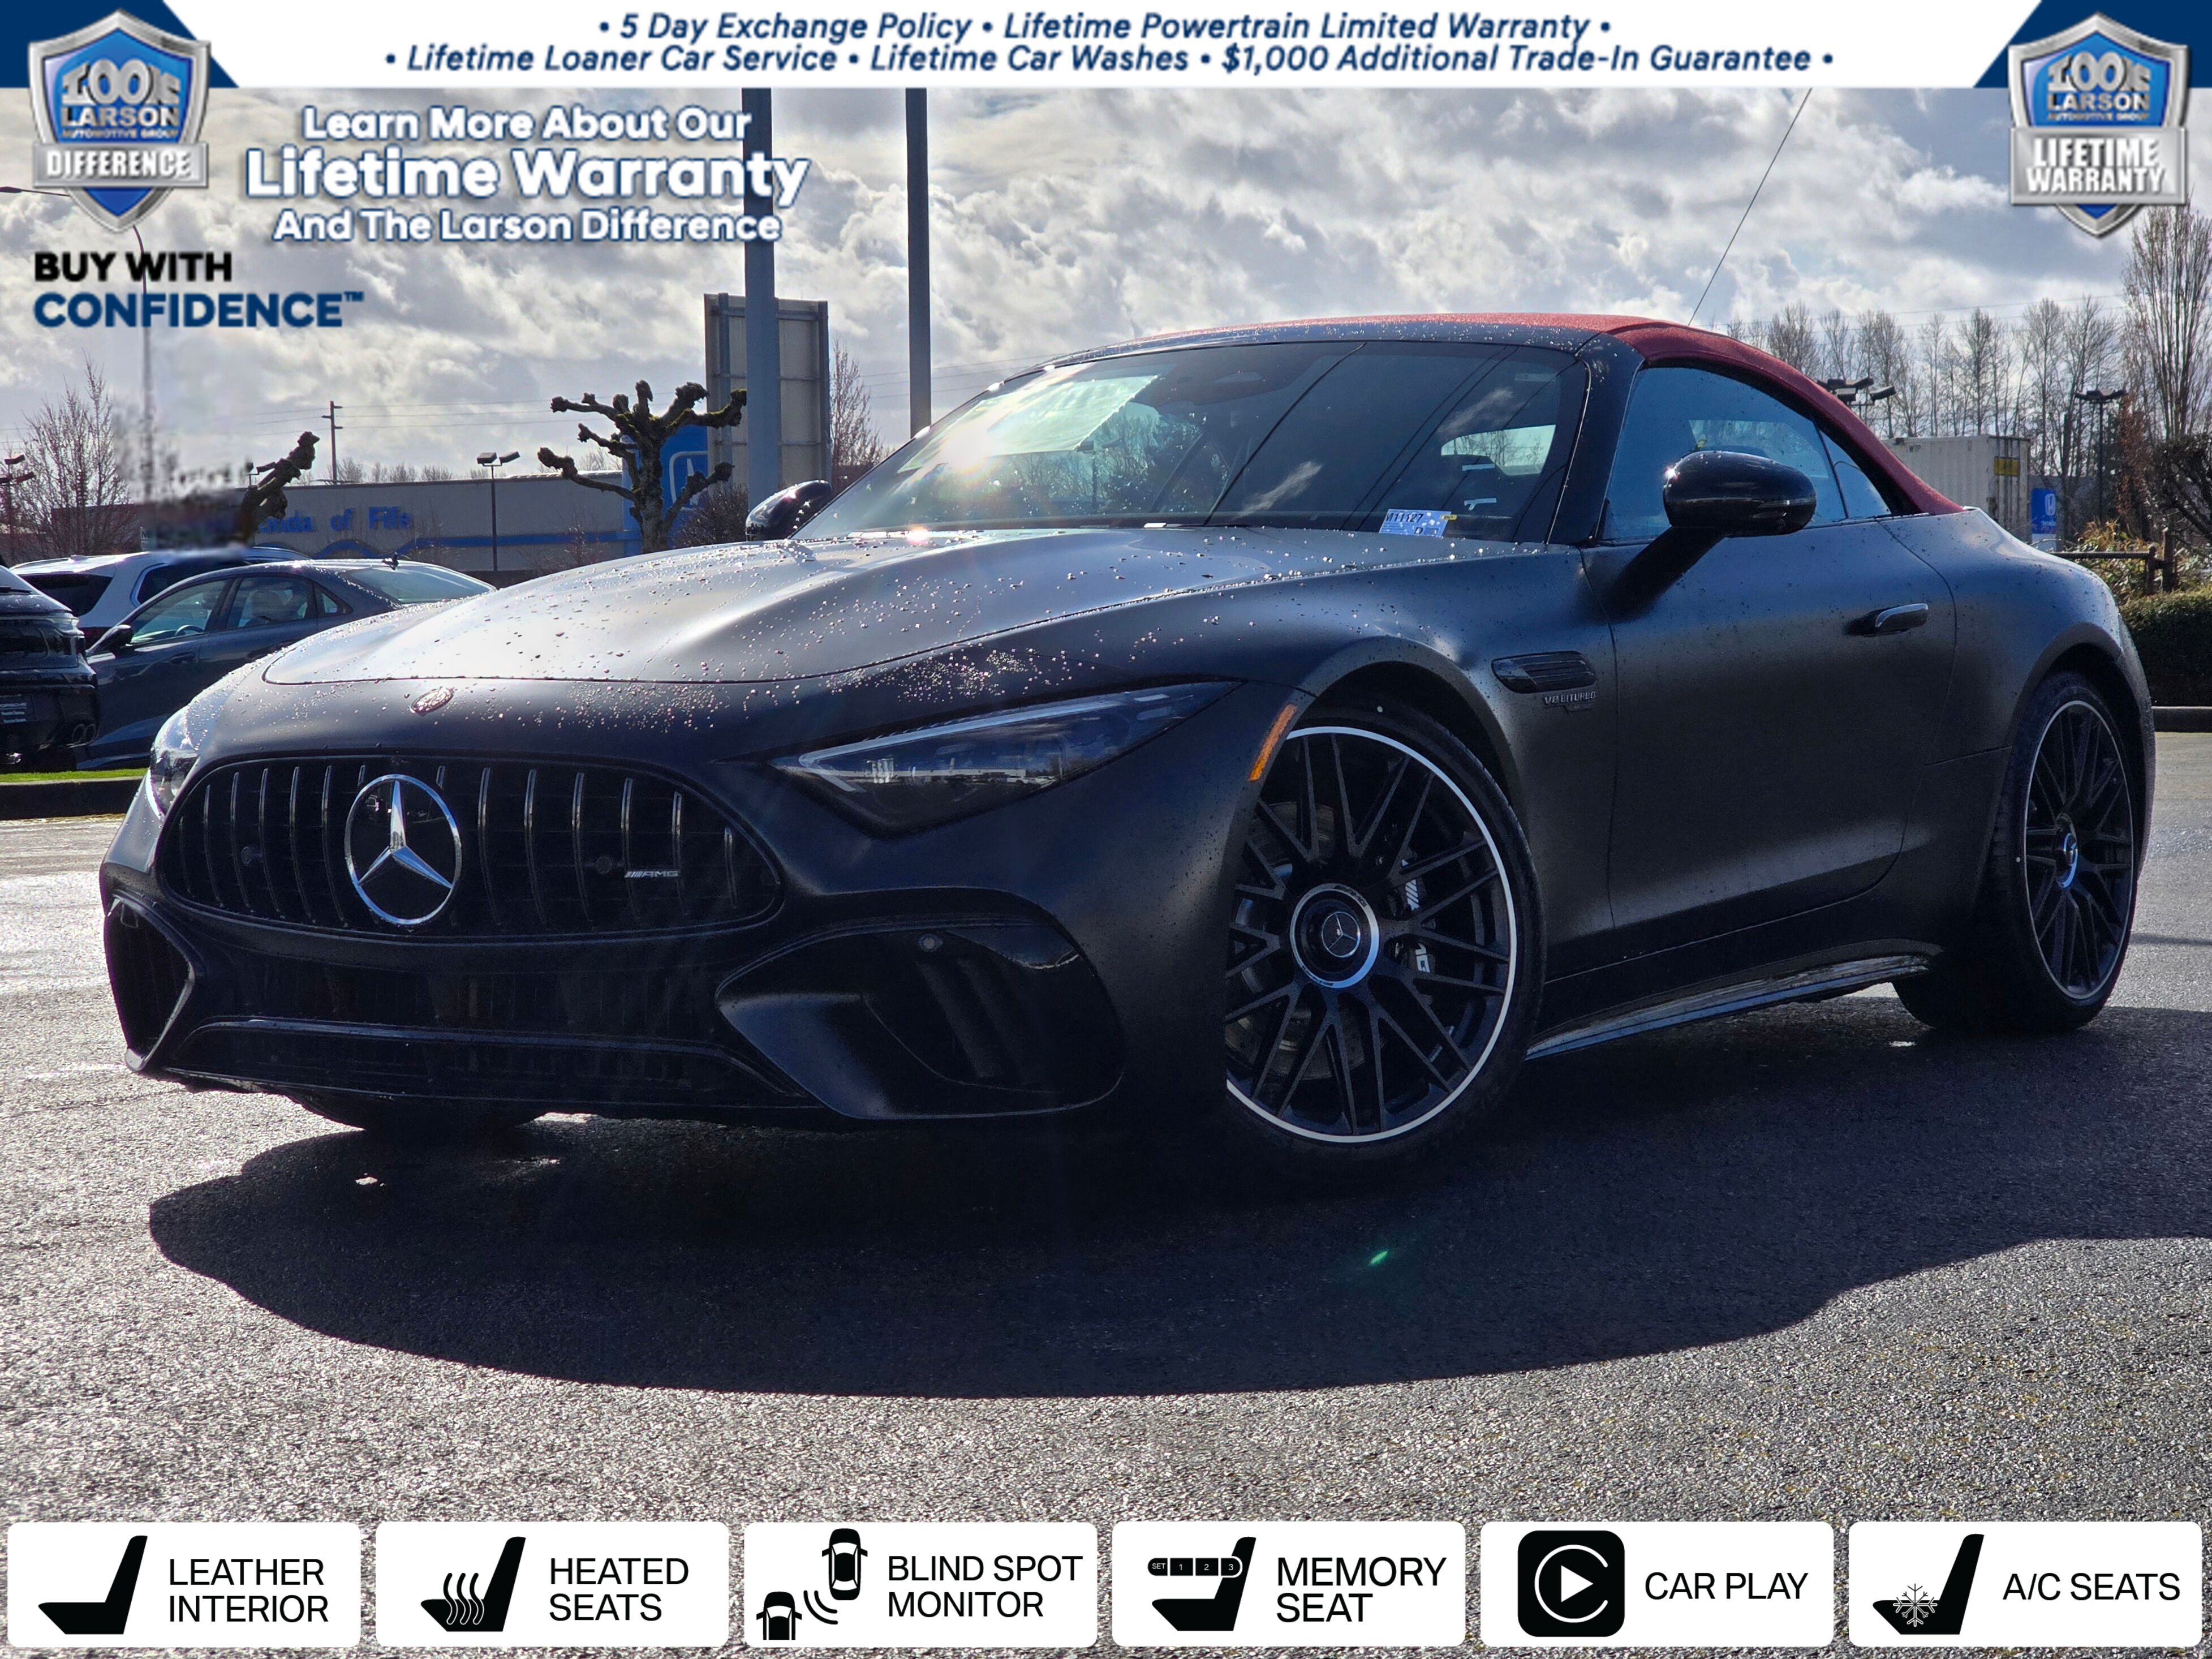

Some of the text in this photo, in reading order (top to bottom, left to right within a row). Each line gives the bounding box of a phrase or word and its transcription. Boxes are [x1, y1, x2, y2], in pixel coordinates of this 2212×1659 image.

[257, 506, 414, 533] onda of Fife
[1560, 690, 1596, 703] BITURBO
